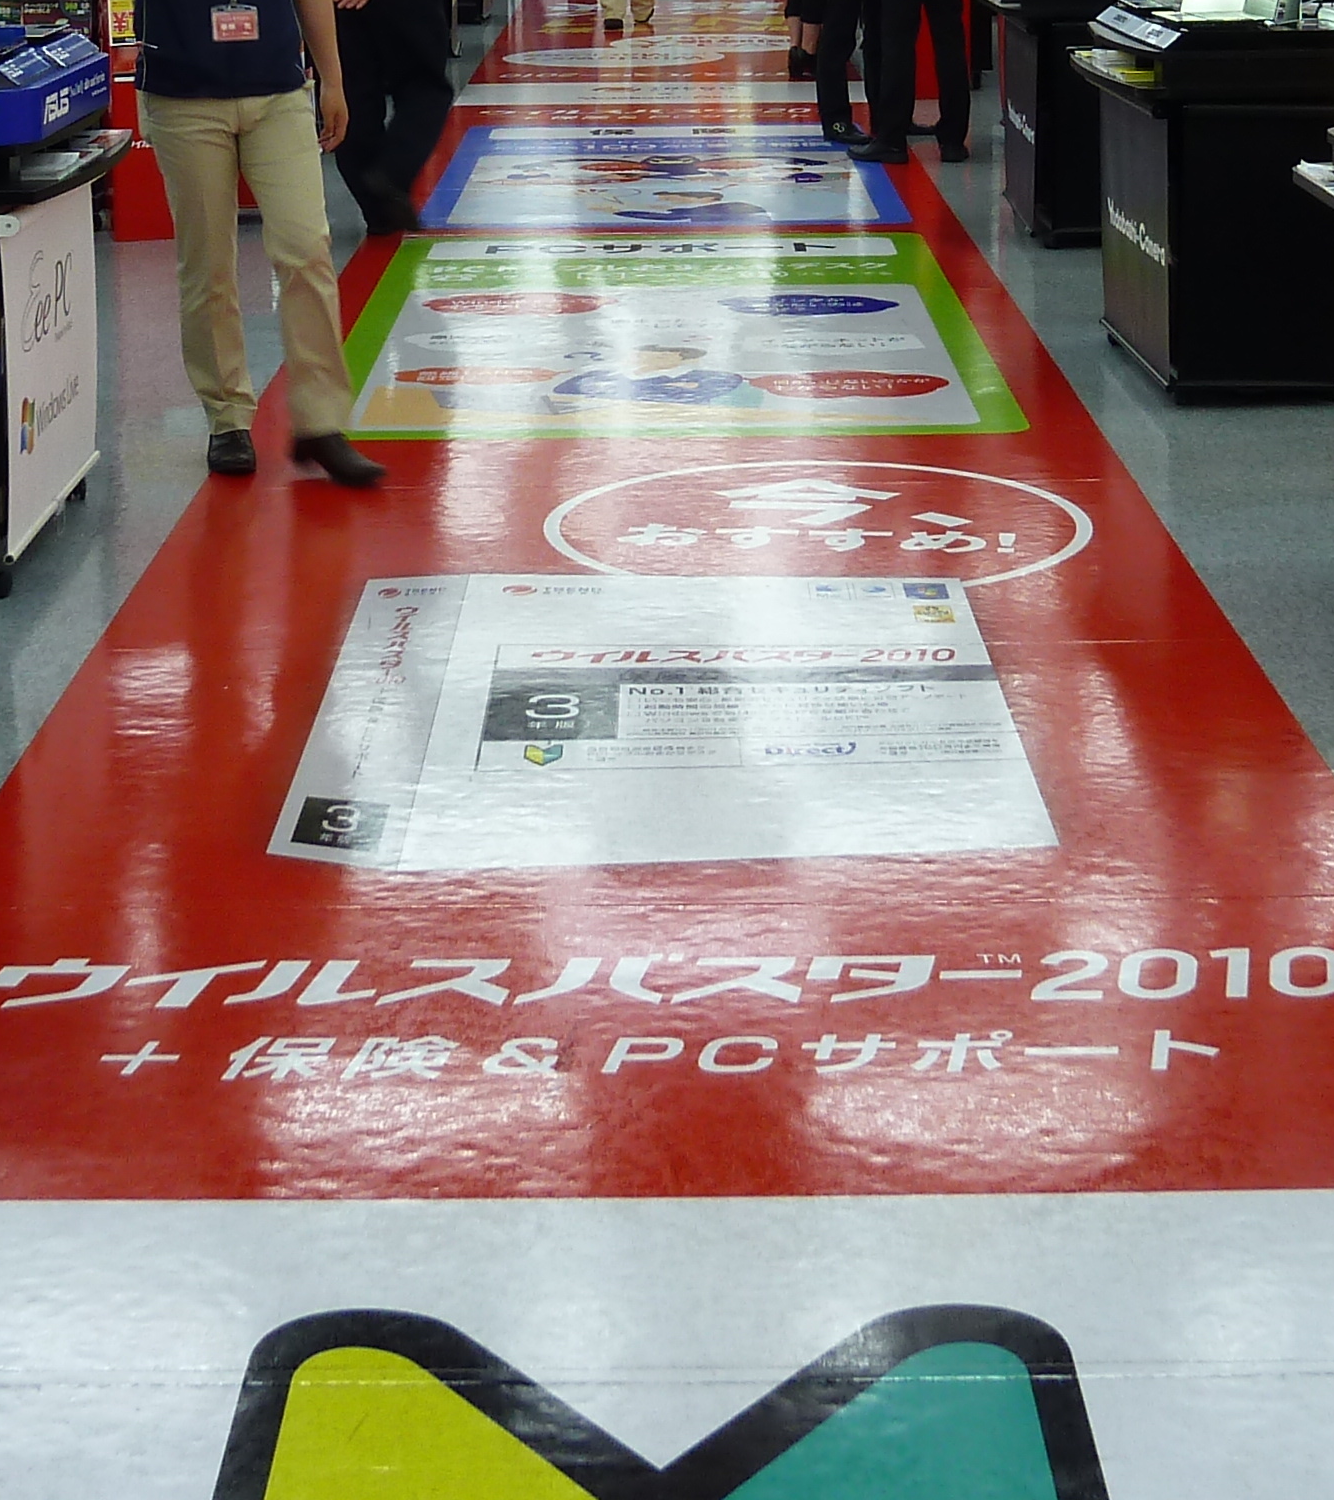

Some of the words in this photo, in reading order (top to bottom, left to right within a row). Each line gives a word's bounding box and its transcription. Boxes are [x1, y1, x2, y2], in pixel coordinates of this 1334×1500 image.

[43, 86, 71, 125] ASUS
[485, 241, 838, 256] PCサポート
[713, 478, 902, 526] 今
[616, 511, 1017, 554] おすすめ!
[530, 646, 958, 664] ウイルスバスター2010
[524, 692, 581, 720] 3
[319, 803, 360, 833] 3
[599, 1028, 1220, 1074] PCサポート
